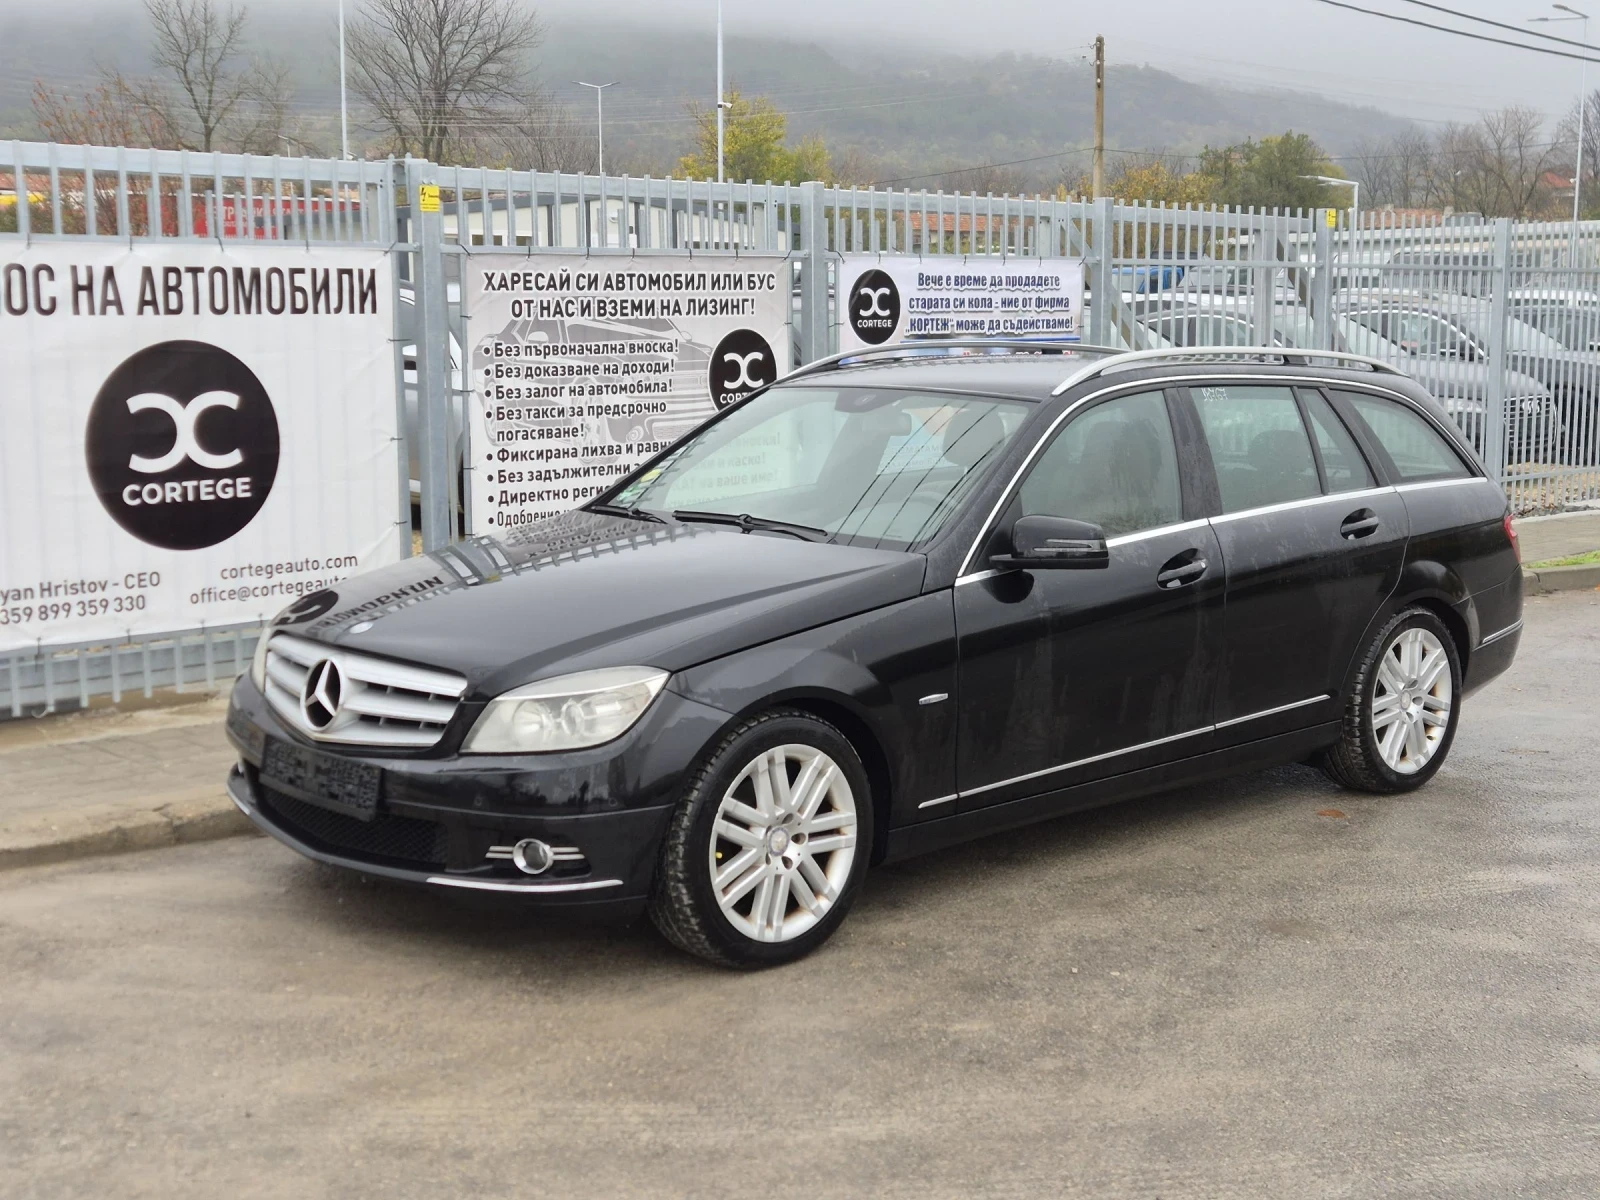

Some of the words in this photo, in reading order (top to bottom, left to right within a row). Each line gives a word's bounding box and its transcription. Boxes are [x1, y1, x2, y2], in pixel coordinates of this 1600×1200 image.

[70, 264, 124, 316] НА
[136, 265, 378, 316] АВТОМОБИЛИ
[482, 268, 571, 292] ХАРЕСАЙ
[575, 271, 598, 291] СИ
[602, 271, 706, 291] АВТОМОБИЛ
[710, 272, 743, 290] ИЛИ
[747, 272, 775, 290] БУС
[917, 272, 943, 287] Вече
[945, 275, 952, 287] е
[954, 275, 987, 288] време
[990, 275, 1003, 288] да
[1005, 275, 1060, 289] продадете
[511, 299, 534, 318] ОТ
[539, 299, 576, 318] НАС
[580, 299, 592, 317] И
[596, 298, 656, 317] ВЗЕМИ
[660, 298, 682, 316] НА
[686, 297, 755, 316] ЛИЗИНГ!
[908, 297, 950, 310] старата
[953, 297, 967, 309] си
[968, 297, 993, 309] кола
[1001, 297, 1019, 309] ние
[1022, 296, 1033, 309] от
[1035, 296, 1070, 310] фирма
[857, 319, 893, 328] CORTEGE
[956, 319, 986, 332] може
[988, 319, 1001, 333] да
[1003, 316, 1073, 333] съдействаме!
[494, 343, 521, 357] Без
[524, 343, 626, 359] първоначална
[628, 339, 679, 354] вноска!
[495, 364, 521, 378] Без
[524, 363, 600, 379] доказване
[603, 363, 619, 375] на
[622, 359, 675, 376] доходи!
[495, 385, 522, 399] Без
[525, 385, 566, 398] залог
[568, 385, 585, 397] на
[588, 379, 673, 396] автомобила!
[496, 406, 522, 421] Без
[526, 406, 565, 419] такси
[568, 405, 584, 417] за
[587, 401, 667, 419] предсрочно
[496, 423, 585, 442] погасяване!
[497, 445, 578, 463] Фиксирана
[581, 442, 622, 458] лихва
[625, 442, 634, 454] и
[497, 469, 523, 484] Без
[527, 463, 631, 483] задължителни
[122, 477, 253, 506] CORTEGE
[498, 488, 569, 508] Директно
[220, 555, 358, 580] cortegeauto.com
[0, 586, 35, 606] yan
[39, 578, 109, 599] Hristov
[124, 571, 161, 590] CEO
[0, 605, 33, 625] 359
[38, 601, 72, 621] 899
[76, 597, 109, 618] 359
[113, 594, 146, 613] 330
